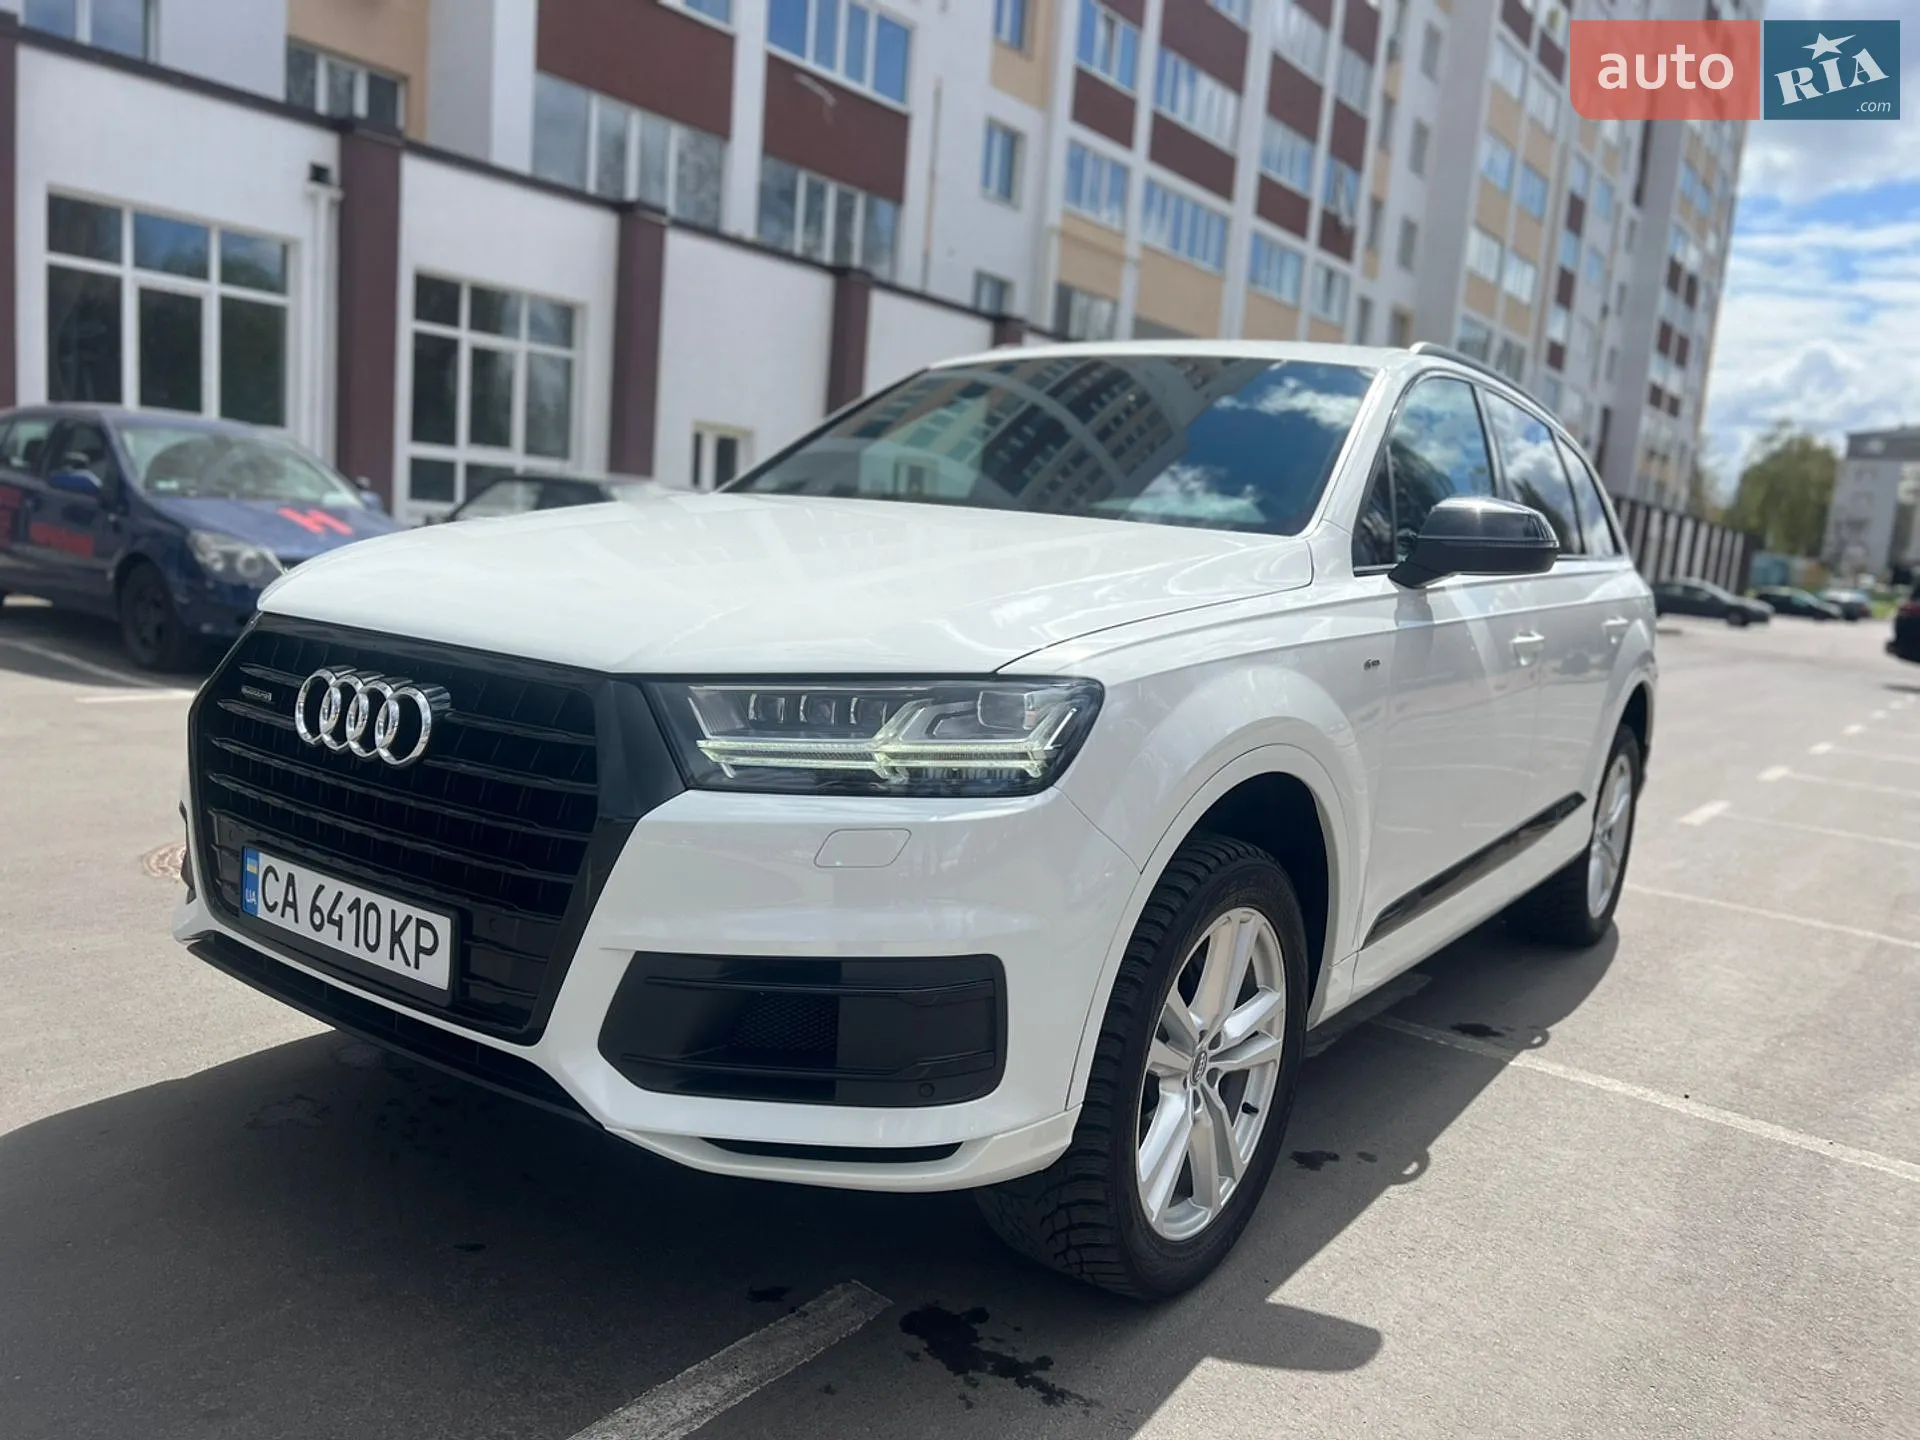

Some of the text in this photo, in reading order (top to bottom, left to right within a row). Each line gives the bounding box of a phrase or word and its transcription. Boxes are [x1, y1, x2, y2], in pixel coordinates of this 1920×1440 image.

[261, 865, 439, 970] CA 6410 KP
